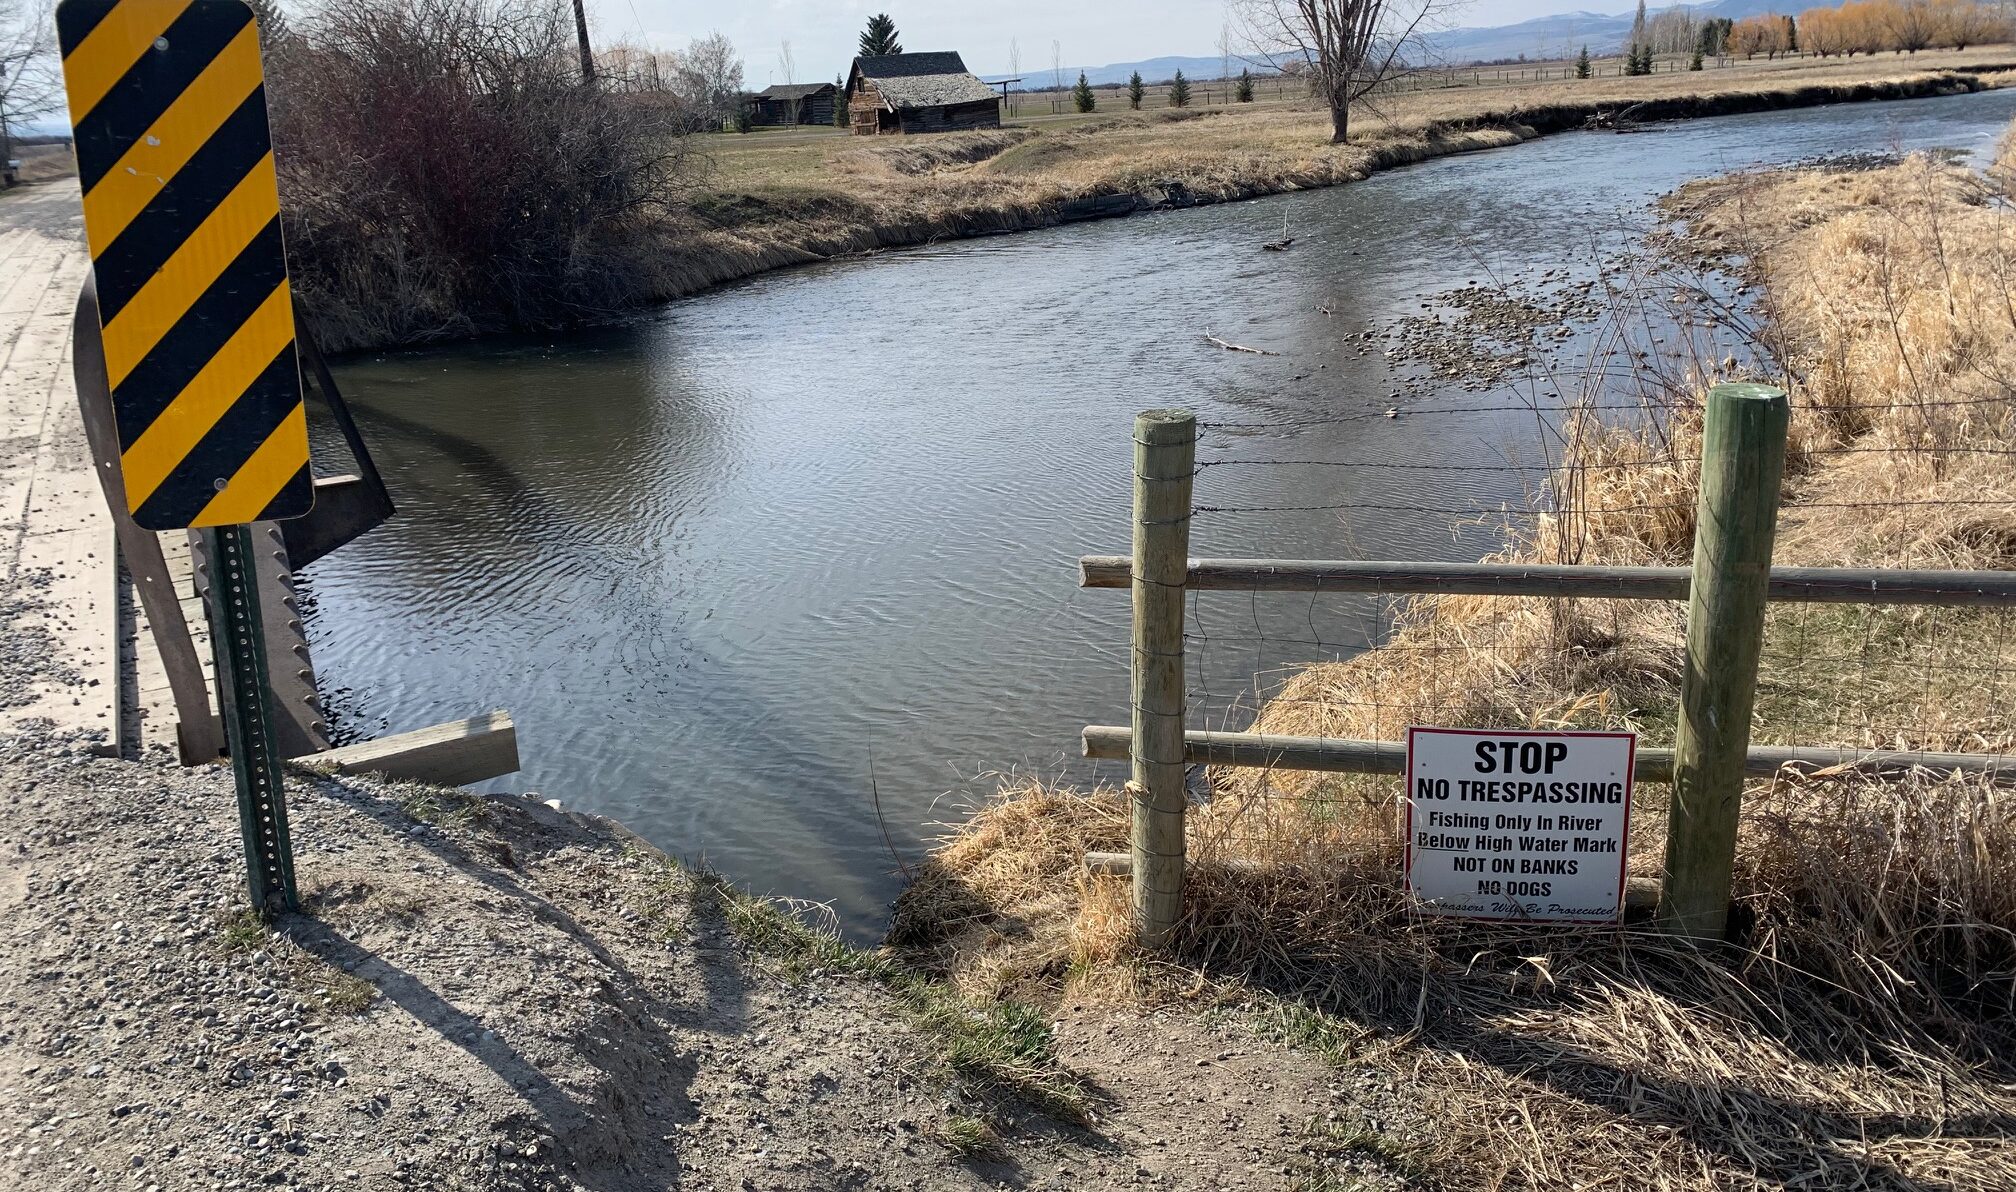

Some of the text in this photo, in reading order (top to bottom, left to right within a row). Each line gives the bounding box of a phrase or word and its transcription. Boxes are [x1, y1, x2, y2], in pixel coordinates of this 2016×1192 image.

[1474, 740, 1568, 775] STOP
[1417, 778, 1623, 804] NO TRESPASSING
[1429, 811, 1603, 832] Fishing Only In River
[1417, 832, 1617, 853] Below High Water Mark
[1453, 856, 1579, 875] NOT ON BANKS
[1477, 879, 1552, 897] NO DOGS
[1525, 903, 1542, 914] Be
[1547, 903, 1617, 916] Prosecuted
